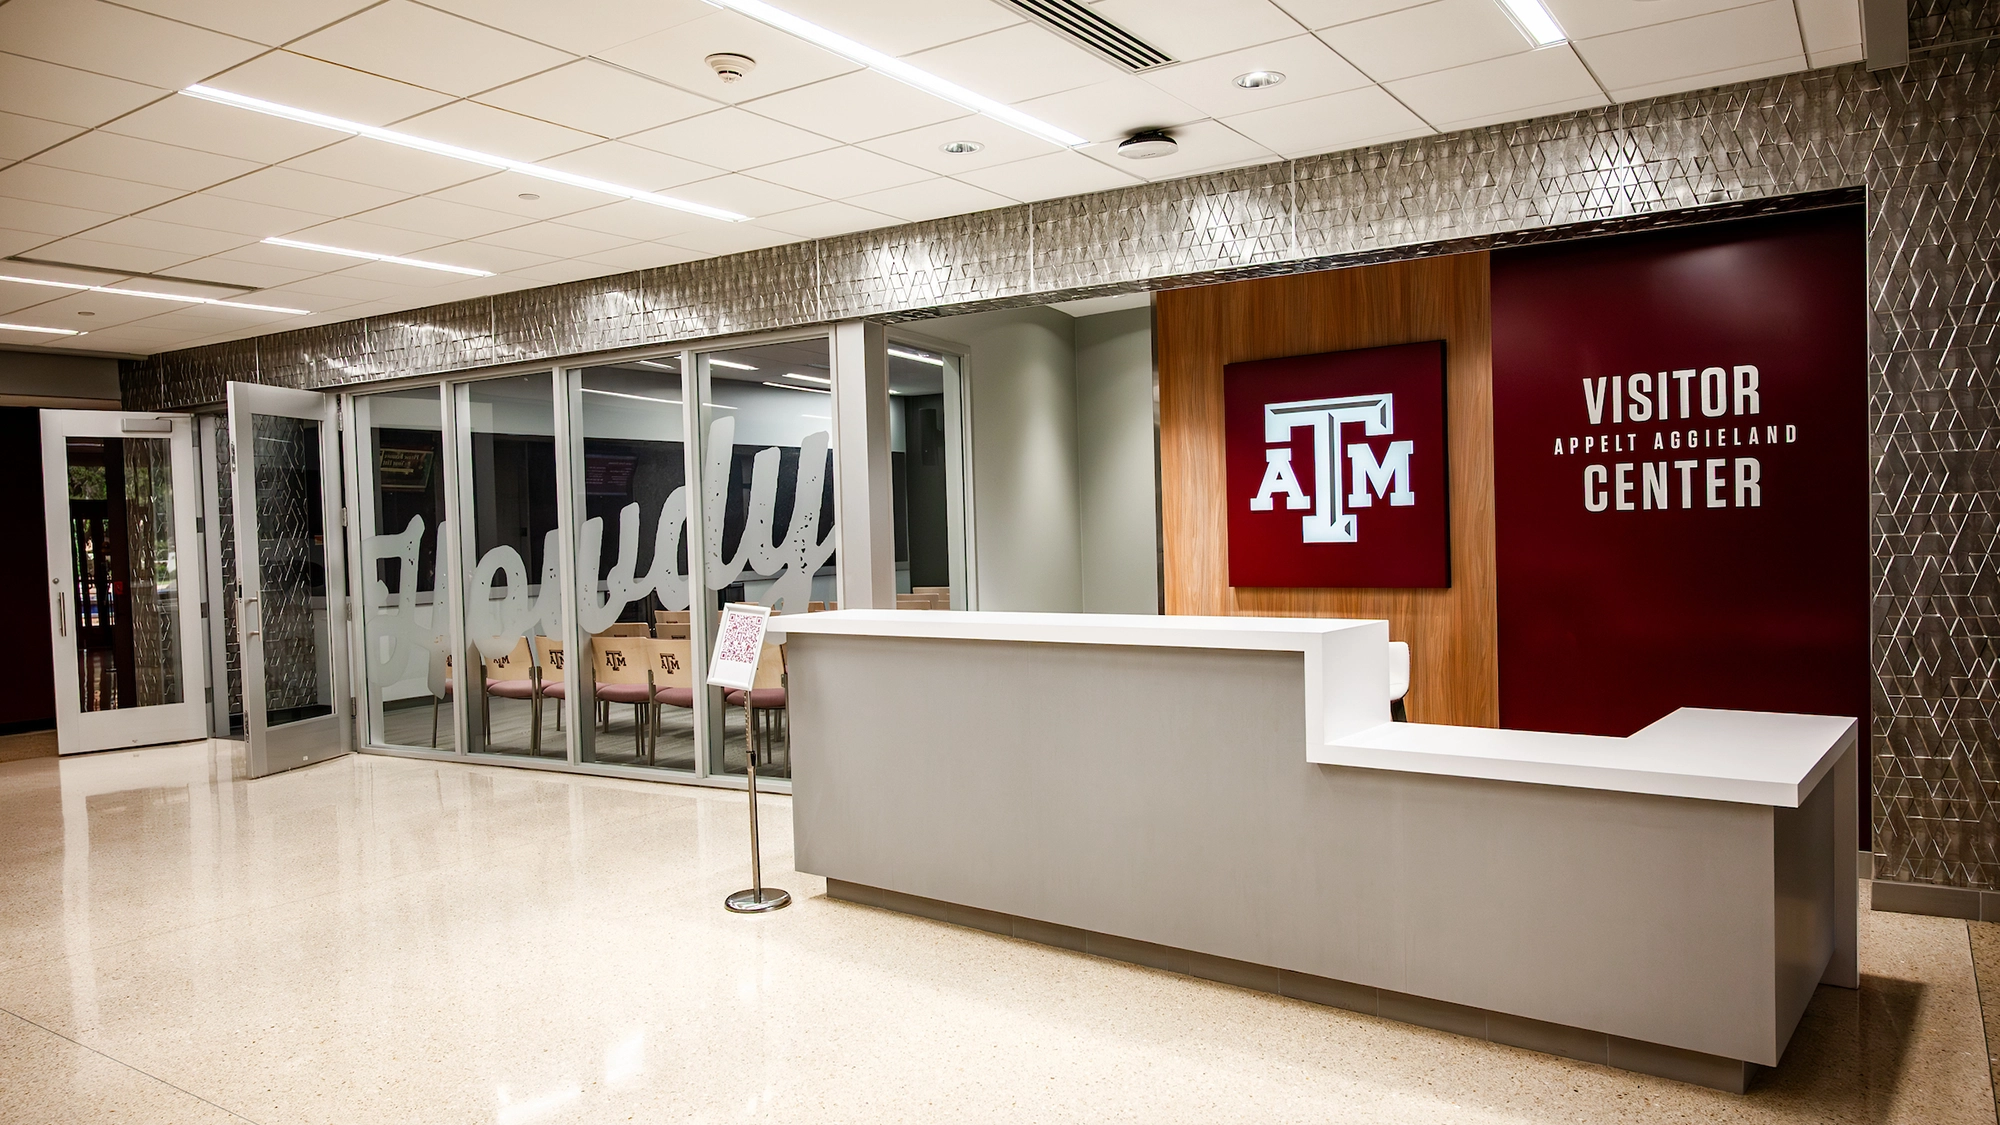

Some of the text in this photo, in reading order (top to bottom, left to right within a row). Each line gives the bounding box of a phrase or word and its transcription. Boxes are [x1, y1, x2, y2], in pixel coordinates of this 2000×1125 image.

[1582, 364, 1760, 425] VISITOR
[1553, 424, 1798, 456] APPELT AGGIELAND
[1583, 457, 1761, 512] CENTER
[362, 416, 837, 700] Howdy
